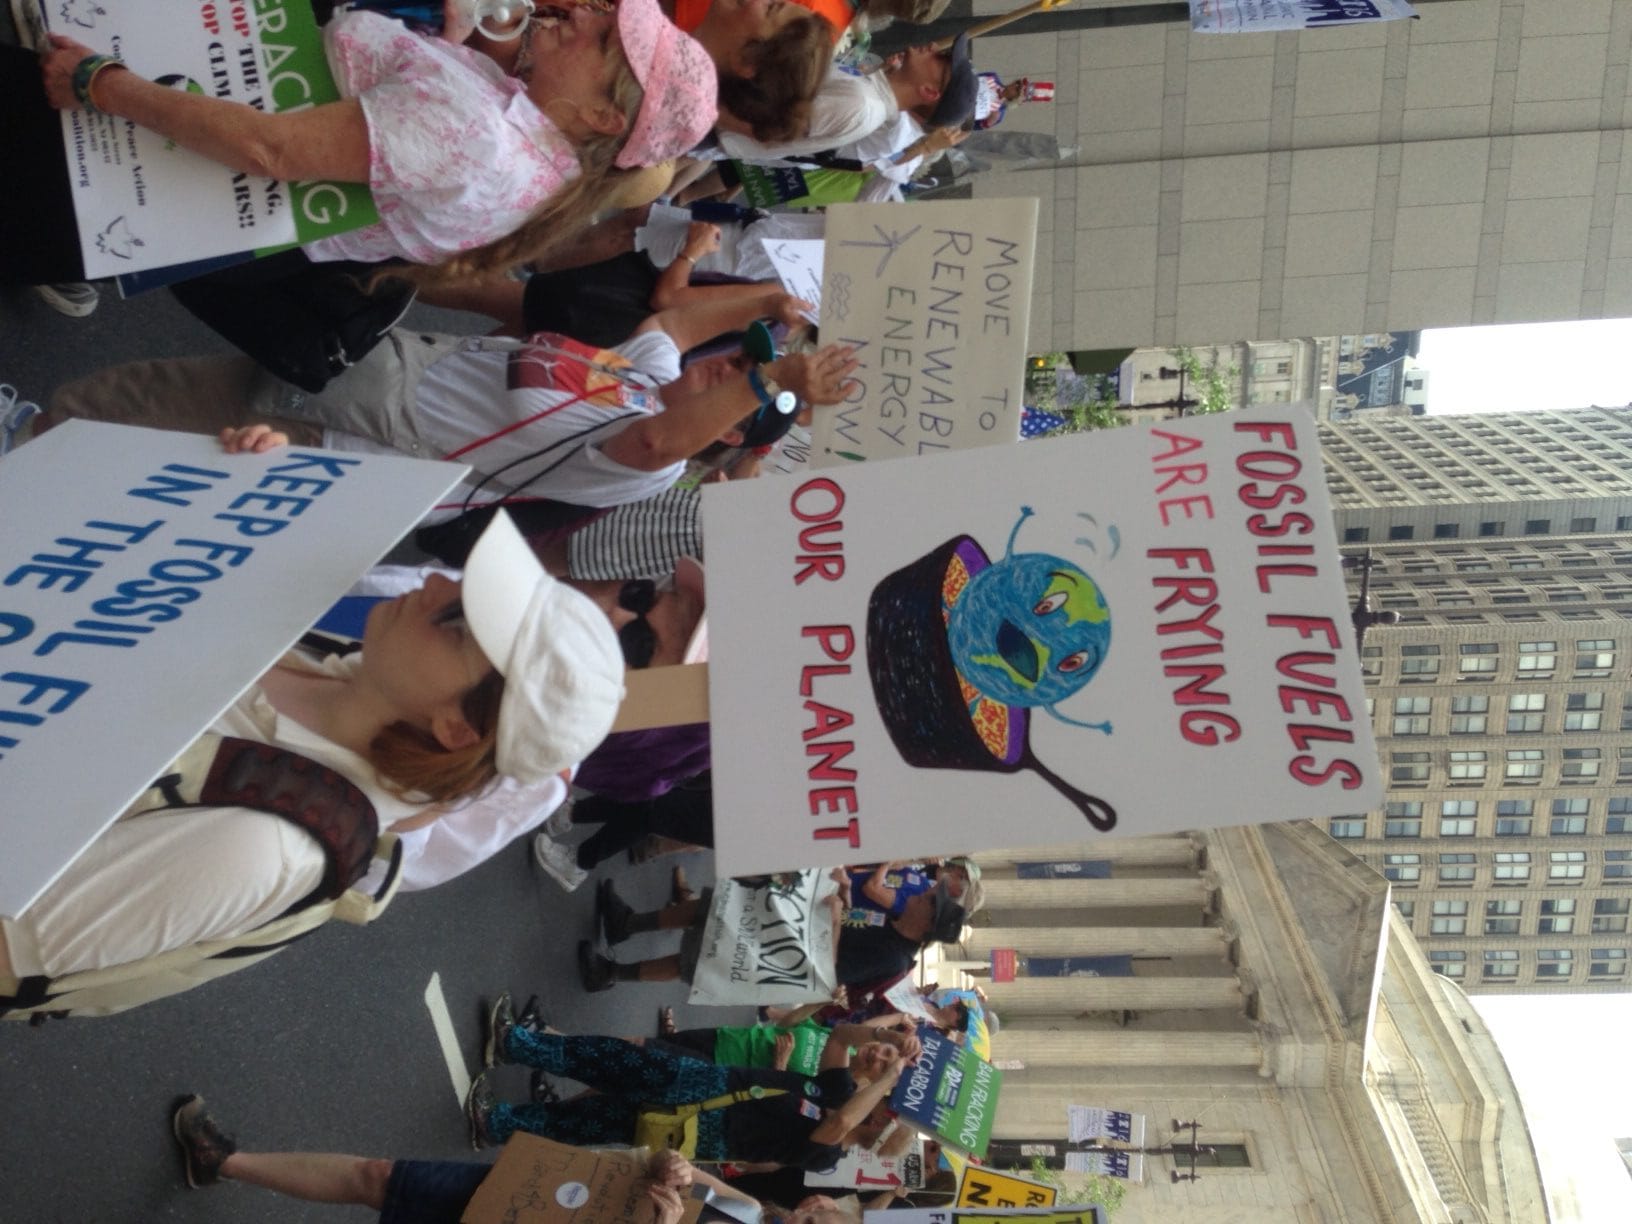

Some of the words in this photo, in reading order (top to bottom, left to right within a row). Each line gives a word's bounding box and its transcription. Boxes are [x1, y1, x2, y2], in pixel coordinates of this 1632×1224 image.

[238, 43, 260, 92] THE
[125, 121, 138, 160] Peace
[133, 165, 147, 206] Action
[208, 42, 232, 98] CLIM
[231, 172, 255, 229] ARS!!
[982, 237, 1019, 336] MOVE
[877, 286, 916, 446] ENERGY
[126, 463, 230, 507] IN
[214, 453, 362, 538] KEEP
[1149, 429, 1215, 527] ARE
[1234, 422, 1318, 594] FOSSIL
[3, 520, 166, 594] THE
[789, 478, 846, 586] OUR
[33, 538, 254, 657] FOSSIL
[1146, 547, 1242, 747] FRYING
[799, 624, 861, 849] PLANET
[1266, 614, 1363, 790] FUELS
[730, 943, 750, 984] world
[902, 1059, 934, 1112] CARBON
[921, 1036, 941, 1059] TAX
[973, 1061, 993, 1088] BAN
[959, 1085, 988, 1148] FRACKING
